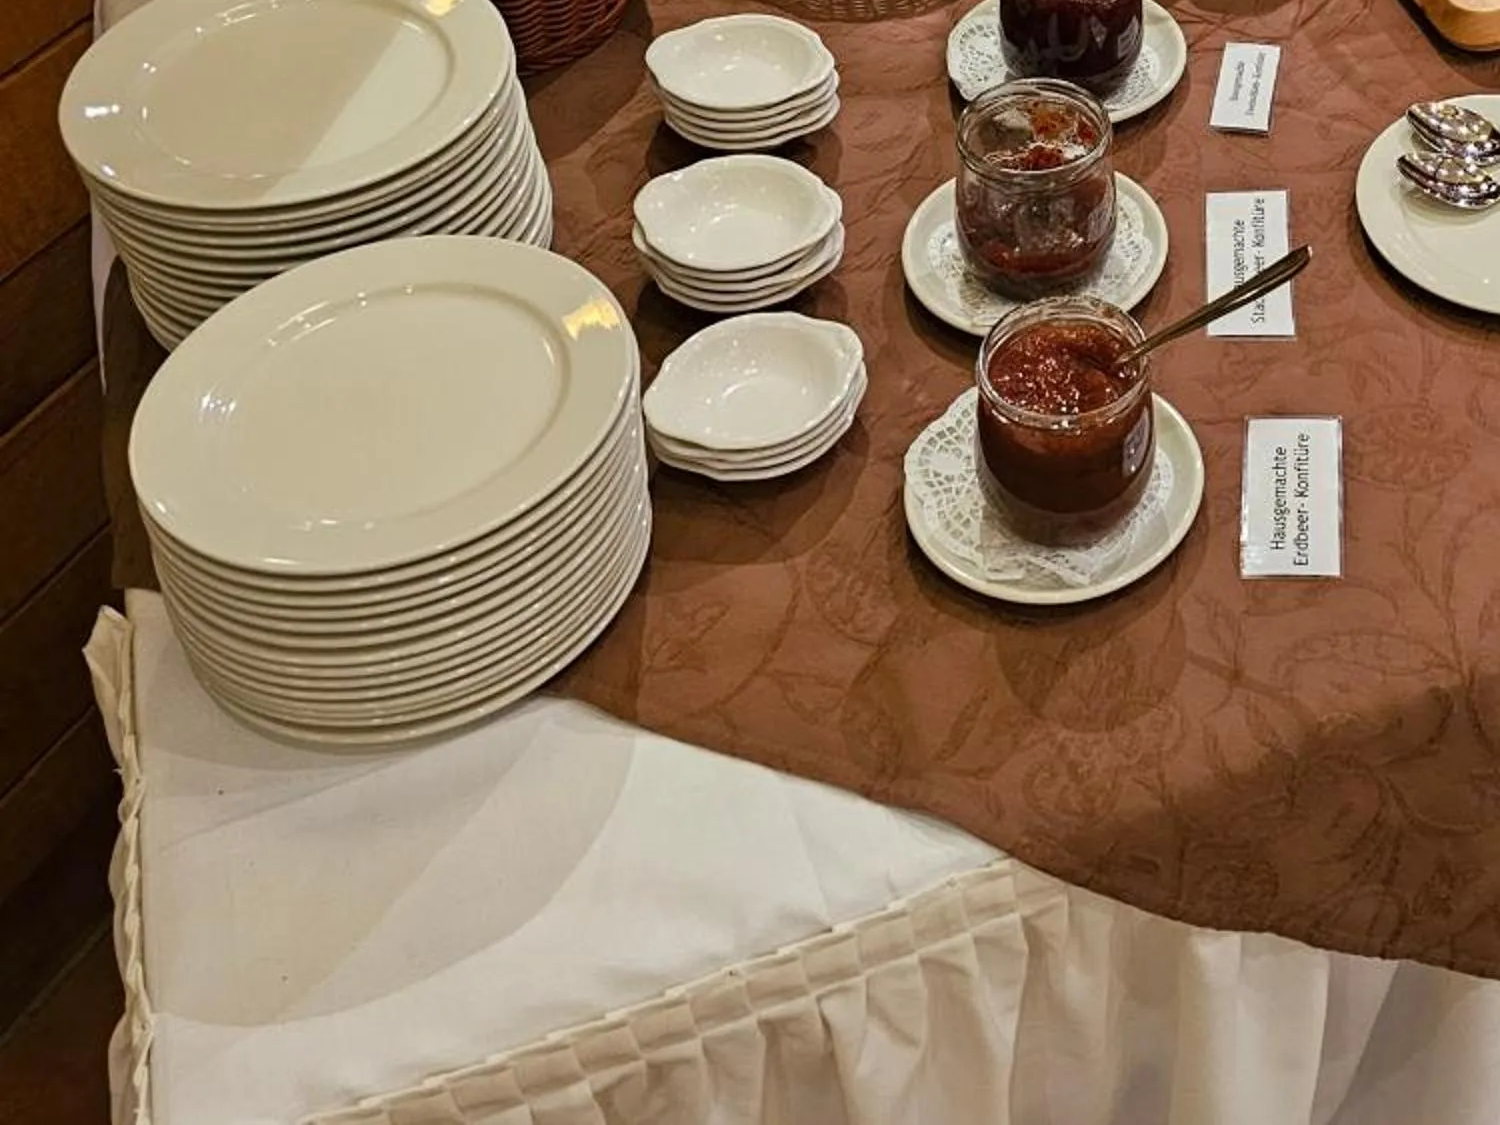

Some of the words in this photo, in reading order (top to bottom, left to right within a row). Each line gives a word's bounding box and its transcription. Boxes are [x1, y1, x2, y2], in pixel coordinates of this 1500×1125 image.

[1293, 432, 1310, 497] Konfitüre
[1271, 446, 1290, 550] Hausgemachte
[1293, 503, 1309, 566] Erdbeer-
